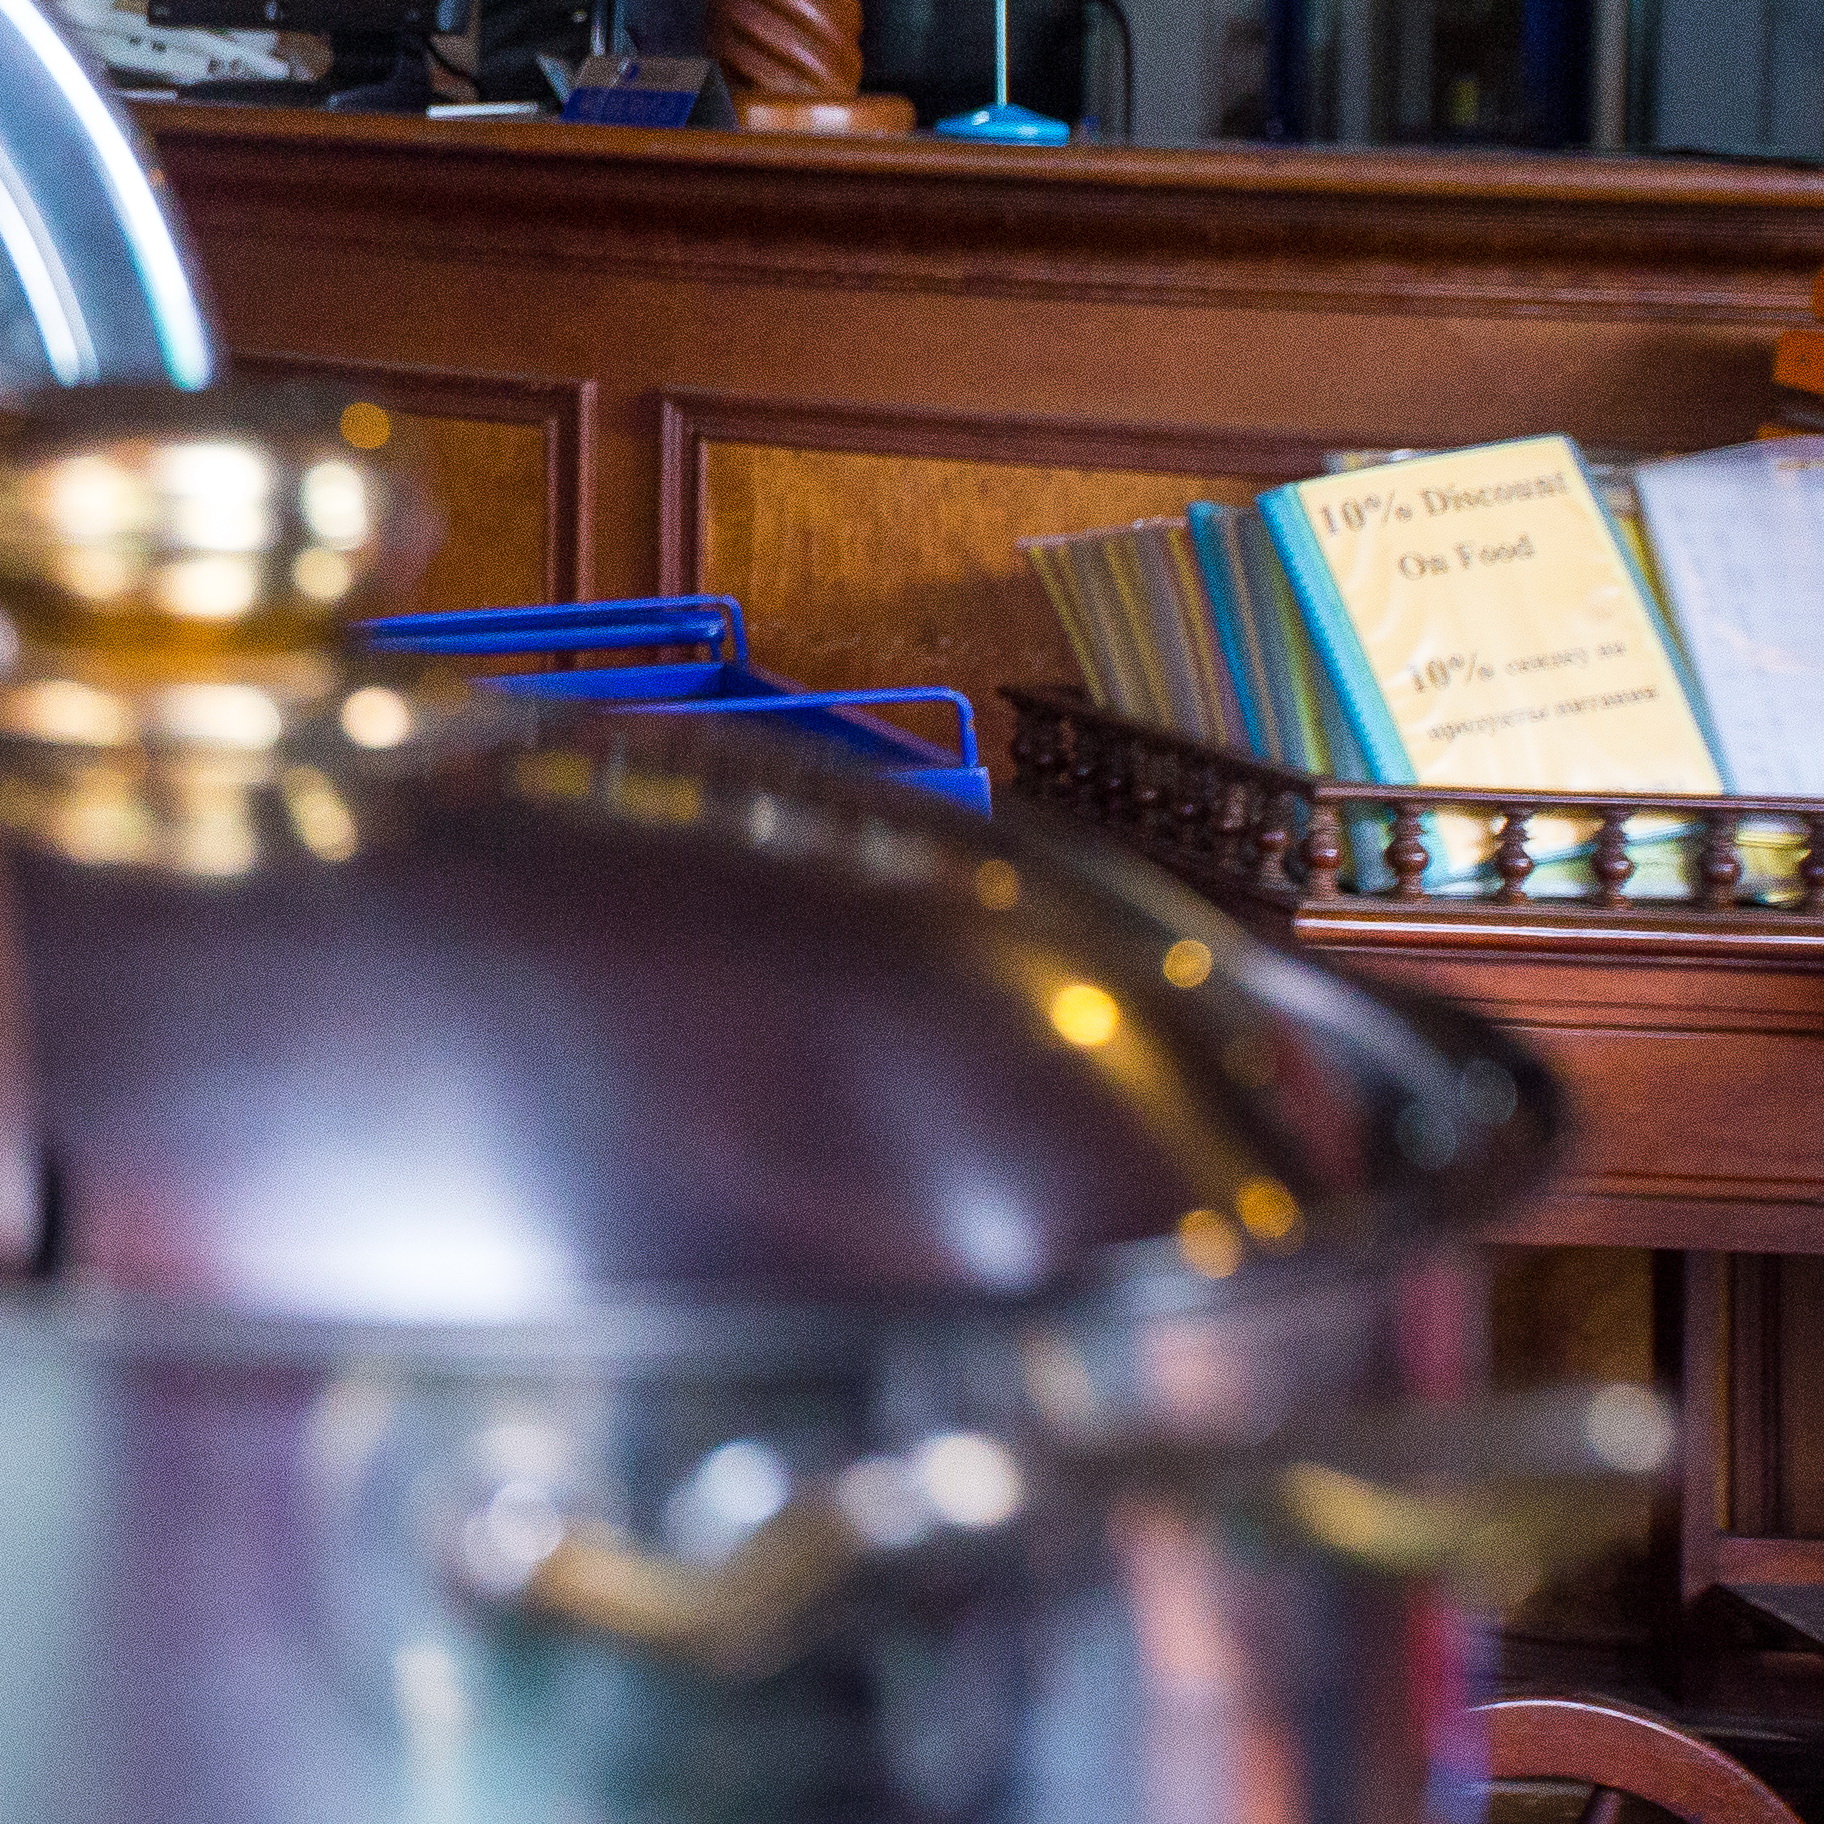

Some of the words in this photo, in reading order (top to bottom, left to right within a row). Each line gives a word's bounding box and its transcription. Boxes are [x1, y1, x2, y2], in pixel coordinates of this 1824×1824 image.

[1317, 487, 1414, 538] 10%
[1421, 468, 1570, 519] Discount
[1396, 549, 1450, 581] On
[1456, 533, 1537, 571] Food
[1409, 651, 1495, 695] 10%
